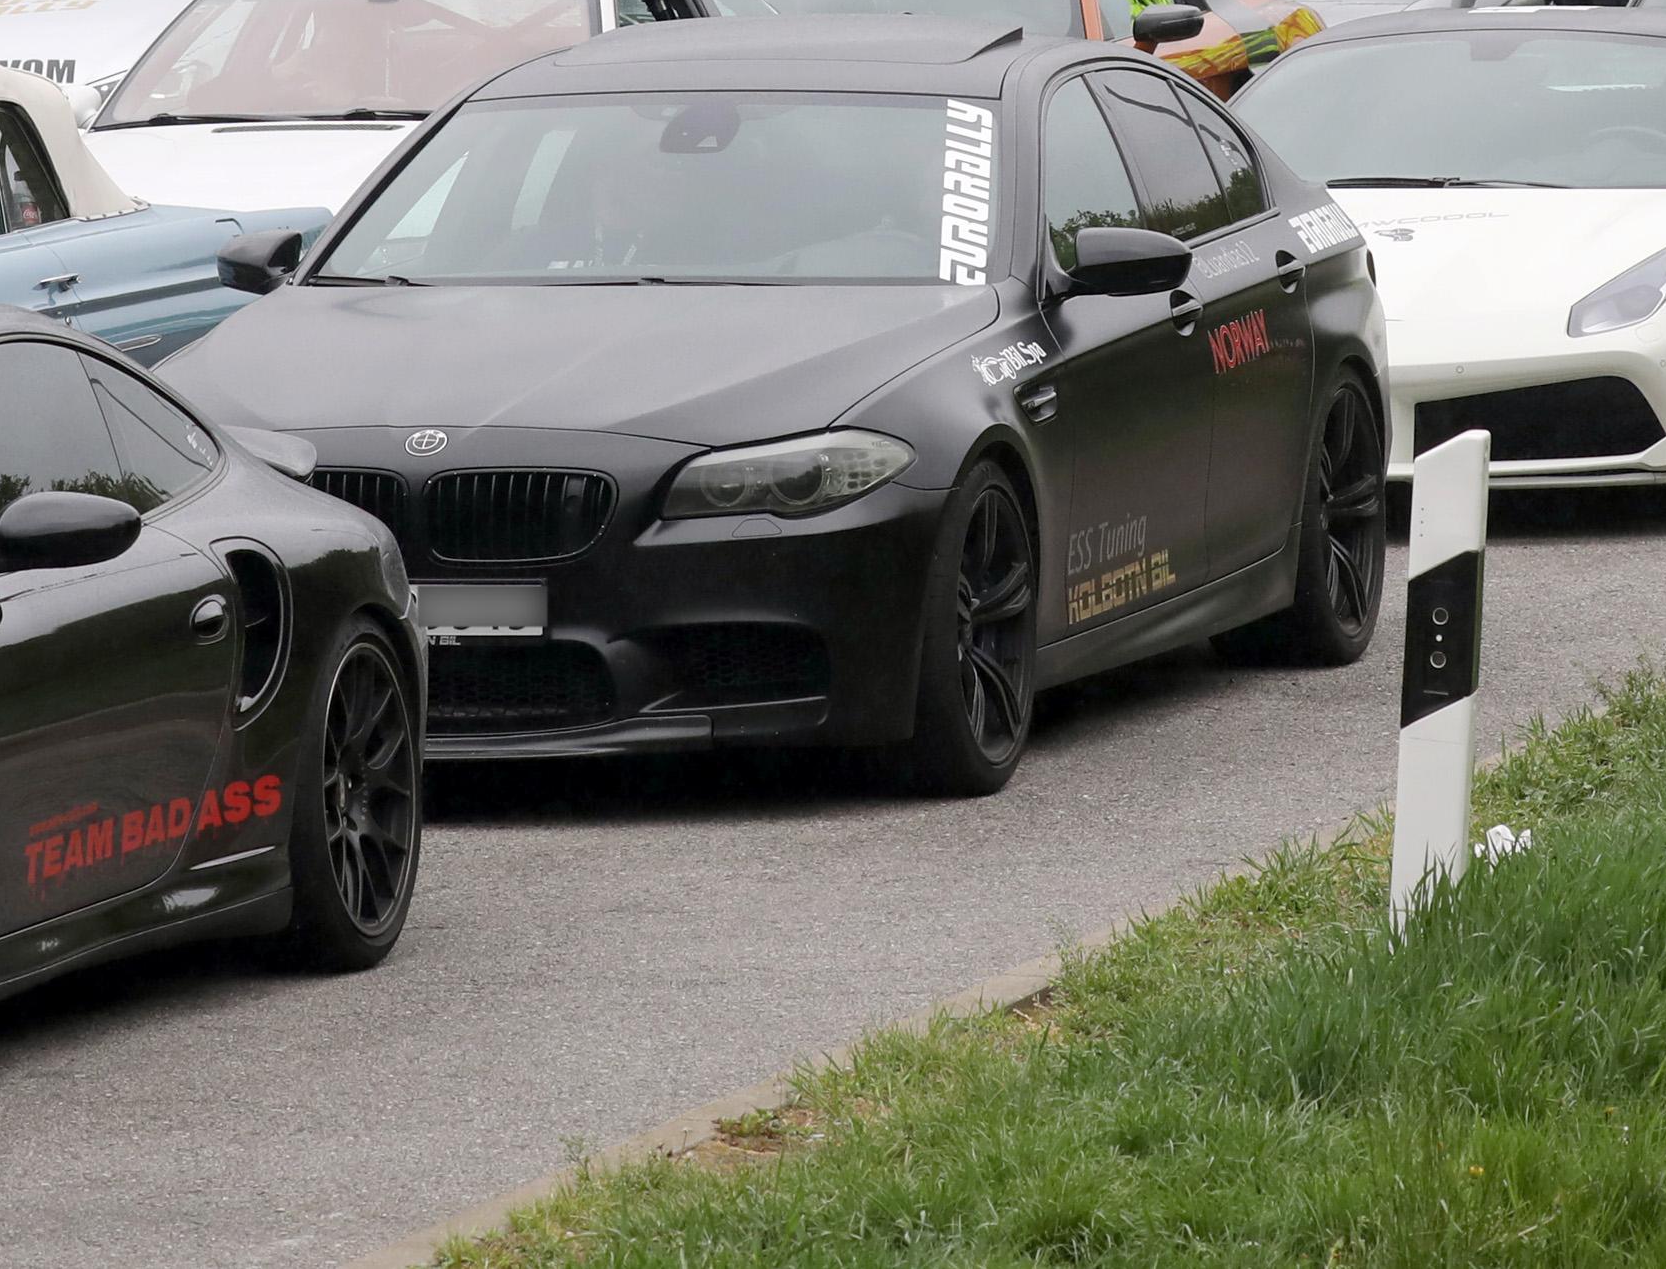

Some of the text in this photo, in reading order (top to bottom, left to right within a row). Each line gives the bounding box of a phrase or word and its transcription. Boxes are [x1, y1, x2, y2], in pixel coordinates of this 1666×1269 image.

[938, 98, 994, 286] EURORALLY
[1208, 308, 1270, 375] NORWAY
[1068, 514, 1148, 576] ESS Tuning
[25, 815, 117, 886] TEAM
[120, 796, 191, 856] BAD
[197, 773, 282, 833] ASS
